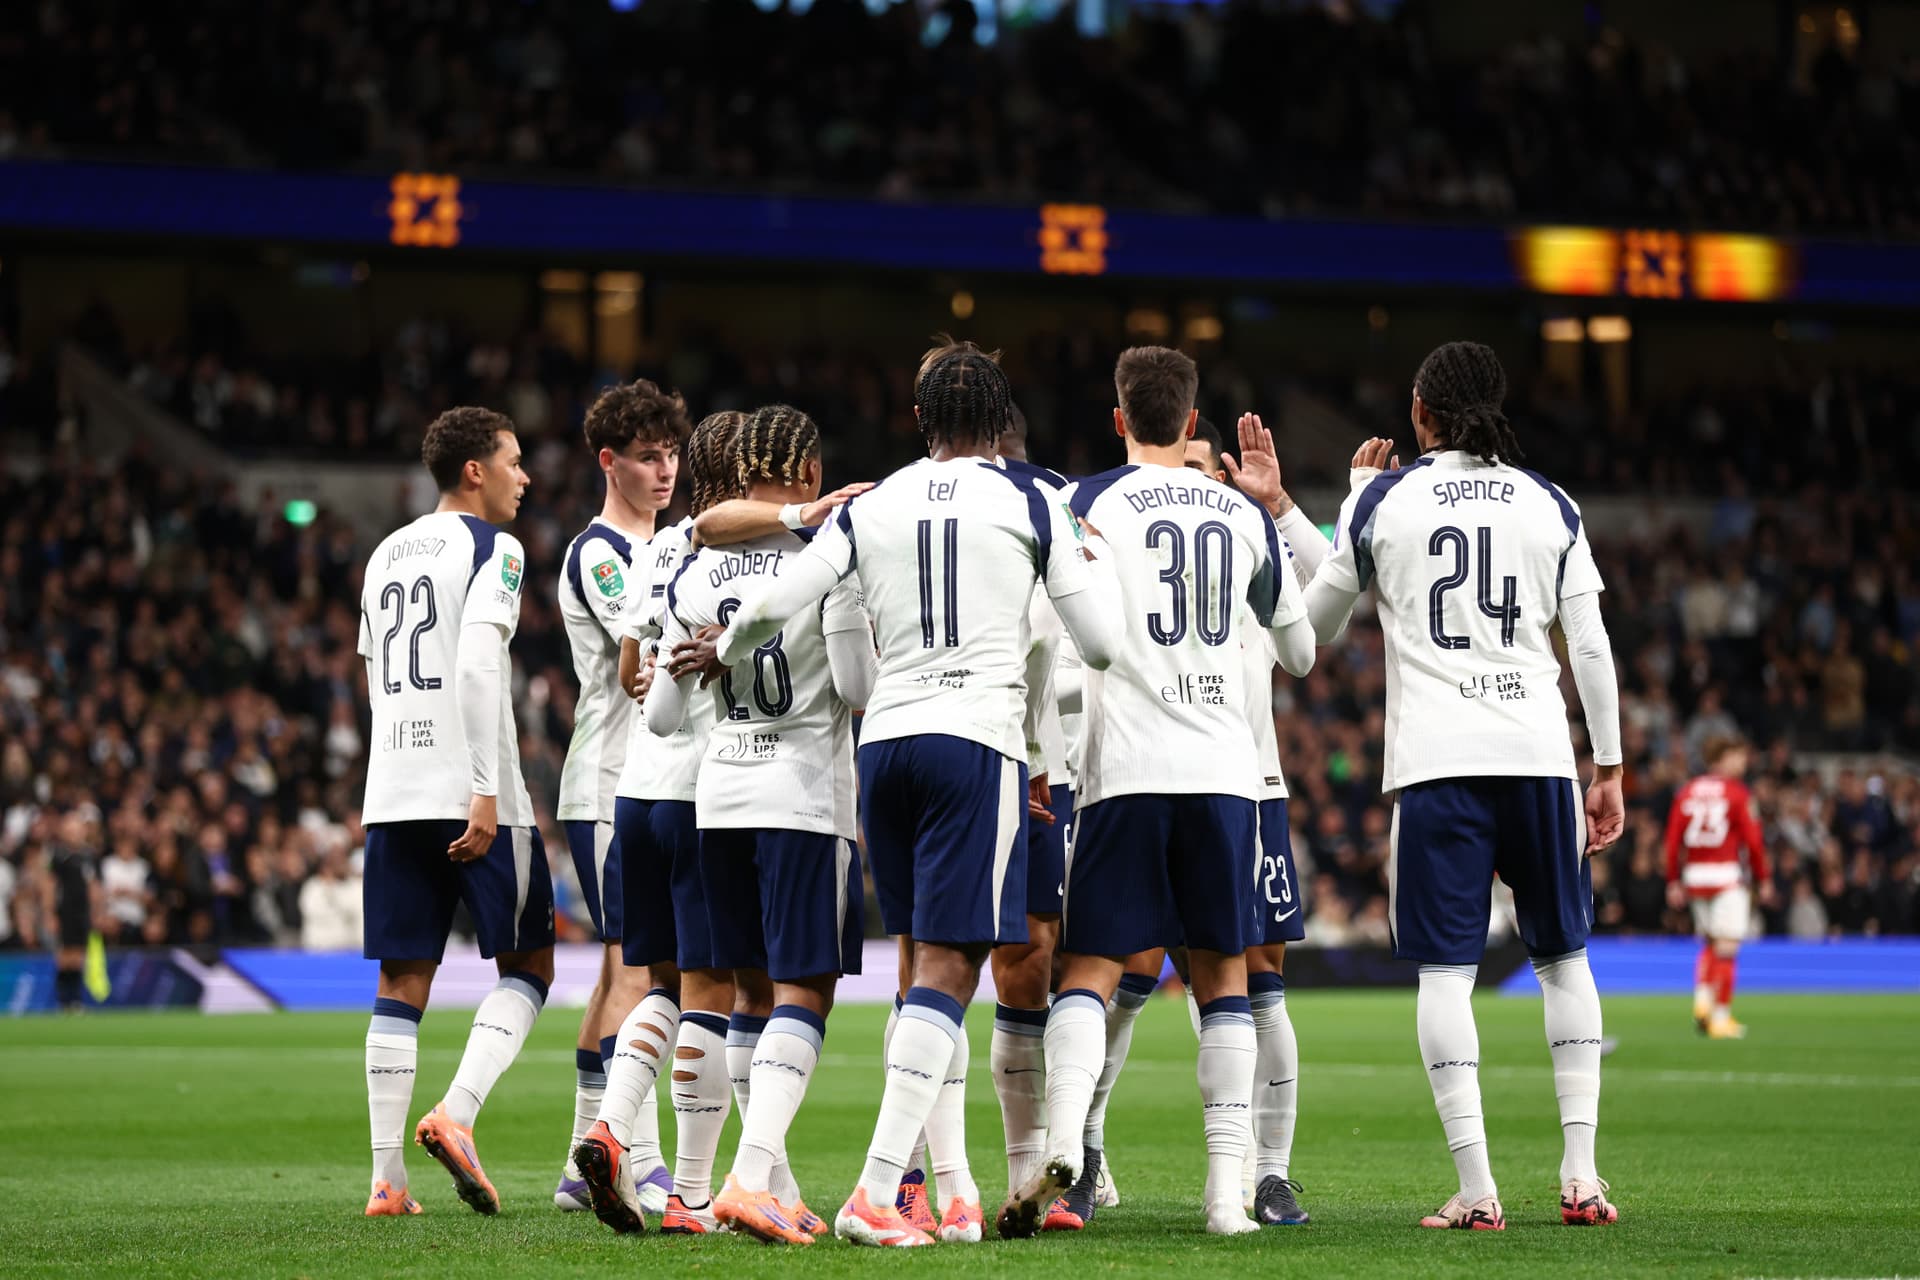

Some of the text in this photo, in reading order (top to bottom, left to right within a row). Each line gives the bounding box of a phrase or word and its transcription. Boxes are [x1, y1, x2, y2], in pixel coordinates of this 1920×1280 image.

[928, 478, 958, 502] tel
[1123, 483, 1242, 516] bentancur
[1433, 480, 1515, 508] spence
[917, 518, 959, 649] 11
[1145, 520, 1233, 647] 30
[1428, 525, 1521, 650] 24
[380, 575, 442, 695] 22
[1264, 855, 1292, 903] 23
